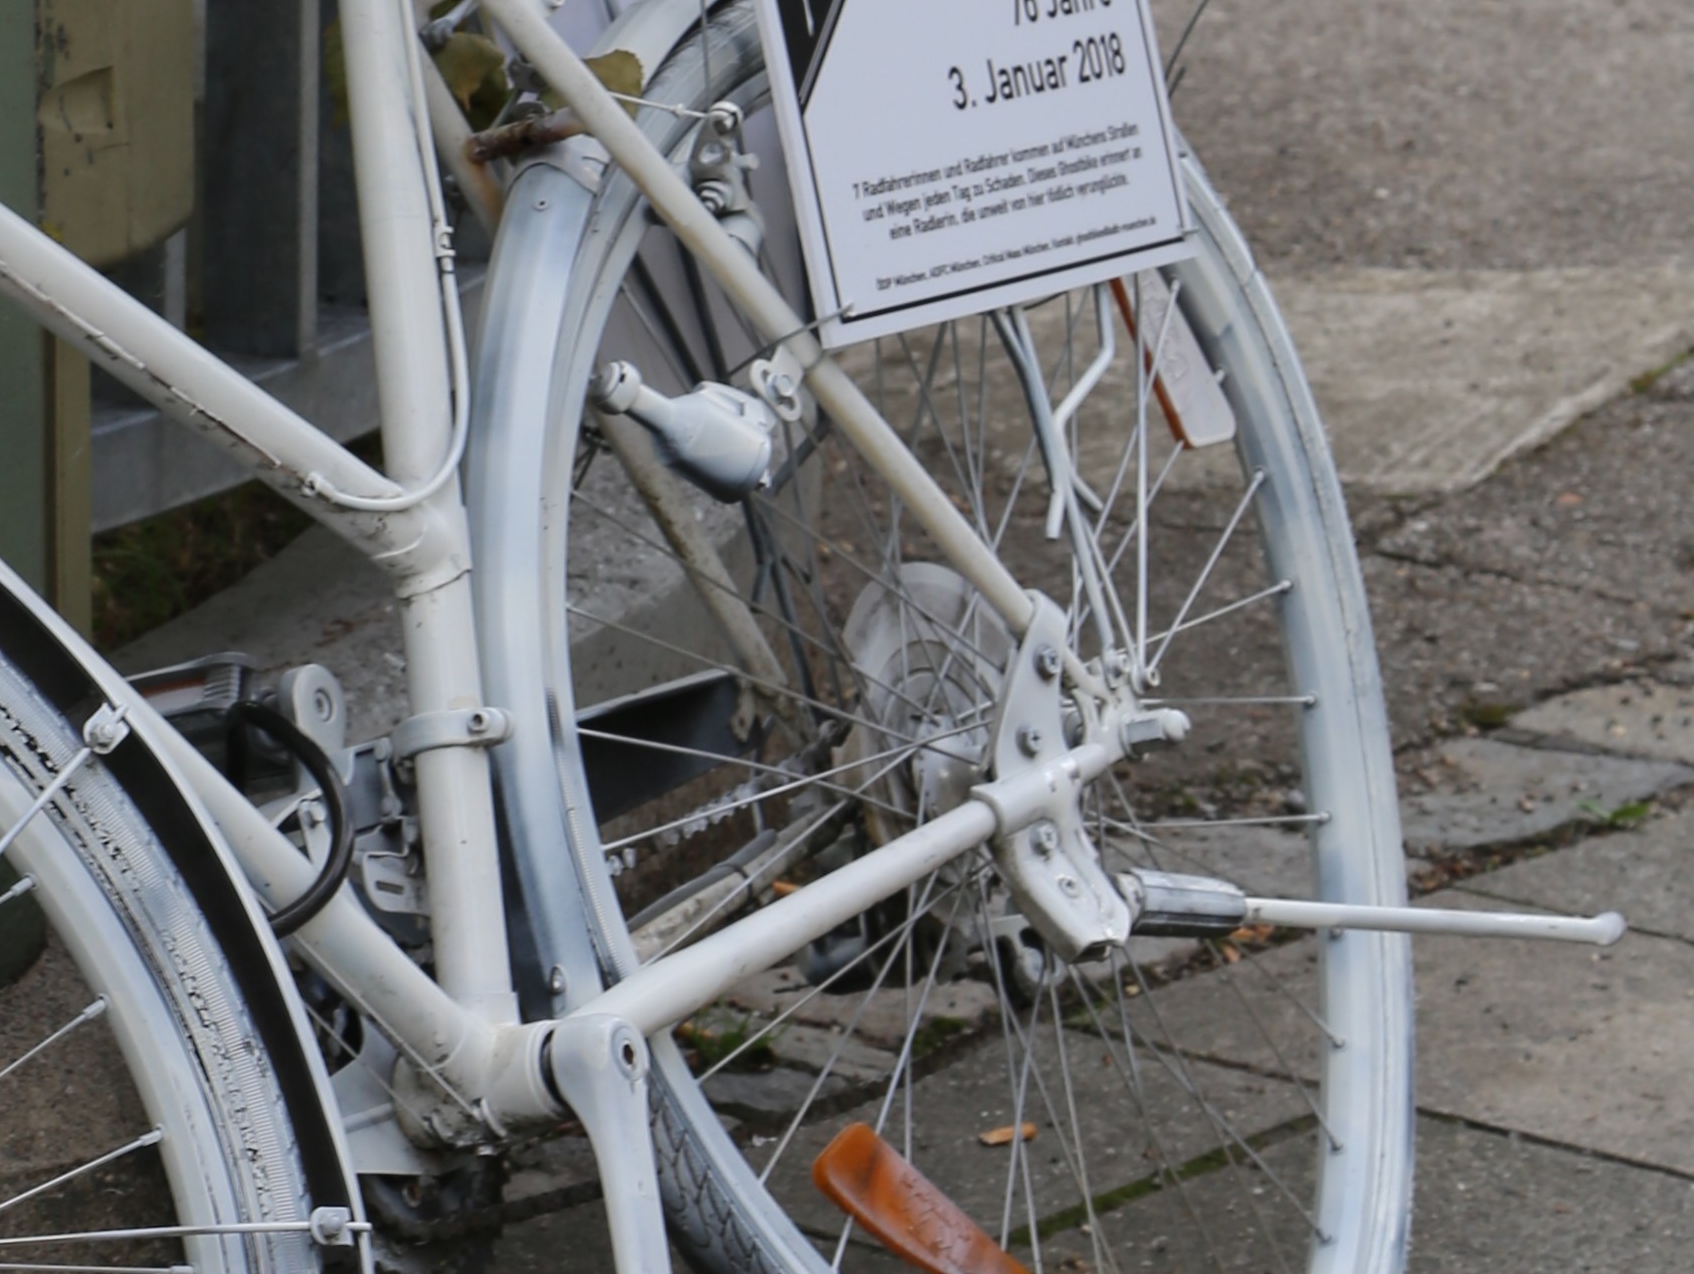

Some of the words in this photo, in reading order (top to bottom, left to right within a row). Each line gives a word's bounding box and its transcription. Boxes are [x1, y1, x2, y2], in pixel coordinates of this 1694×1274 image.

[948, 66, 977, 111] 3.
[986, 55, 1067, 104] Januar
[1073, 32, 1125, 83] 2018
[853, 182, 860, 199] 7
[944, 161, 964, 179] und
[964, 153, 1009, 173] Radfahrer
[1011, 144, 1050, 163] kommen
[864, 203, 885, 221] und
[885, 198, 921, 216] Wegen
[924, 191, 951, 211] jeden
[952, 184, 972, 202] Tag
[972, 183, 985, 196] zu
[985, 174, 1026, 193] Schaden.
[890, 224, 912, 239] eine
[914, 214, 959, 232] Radlerin,
[961, 207, 977, 223] die
[1010, 197, 1027, 210] von
[1028, 193, 1046, 206] hier
